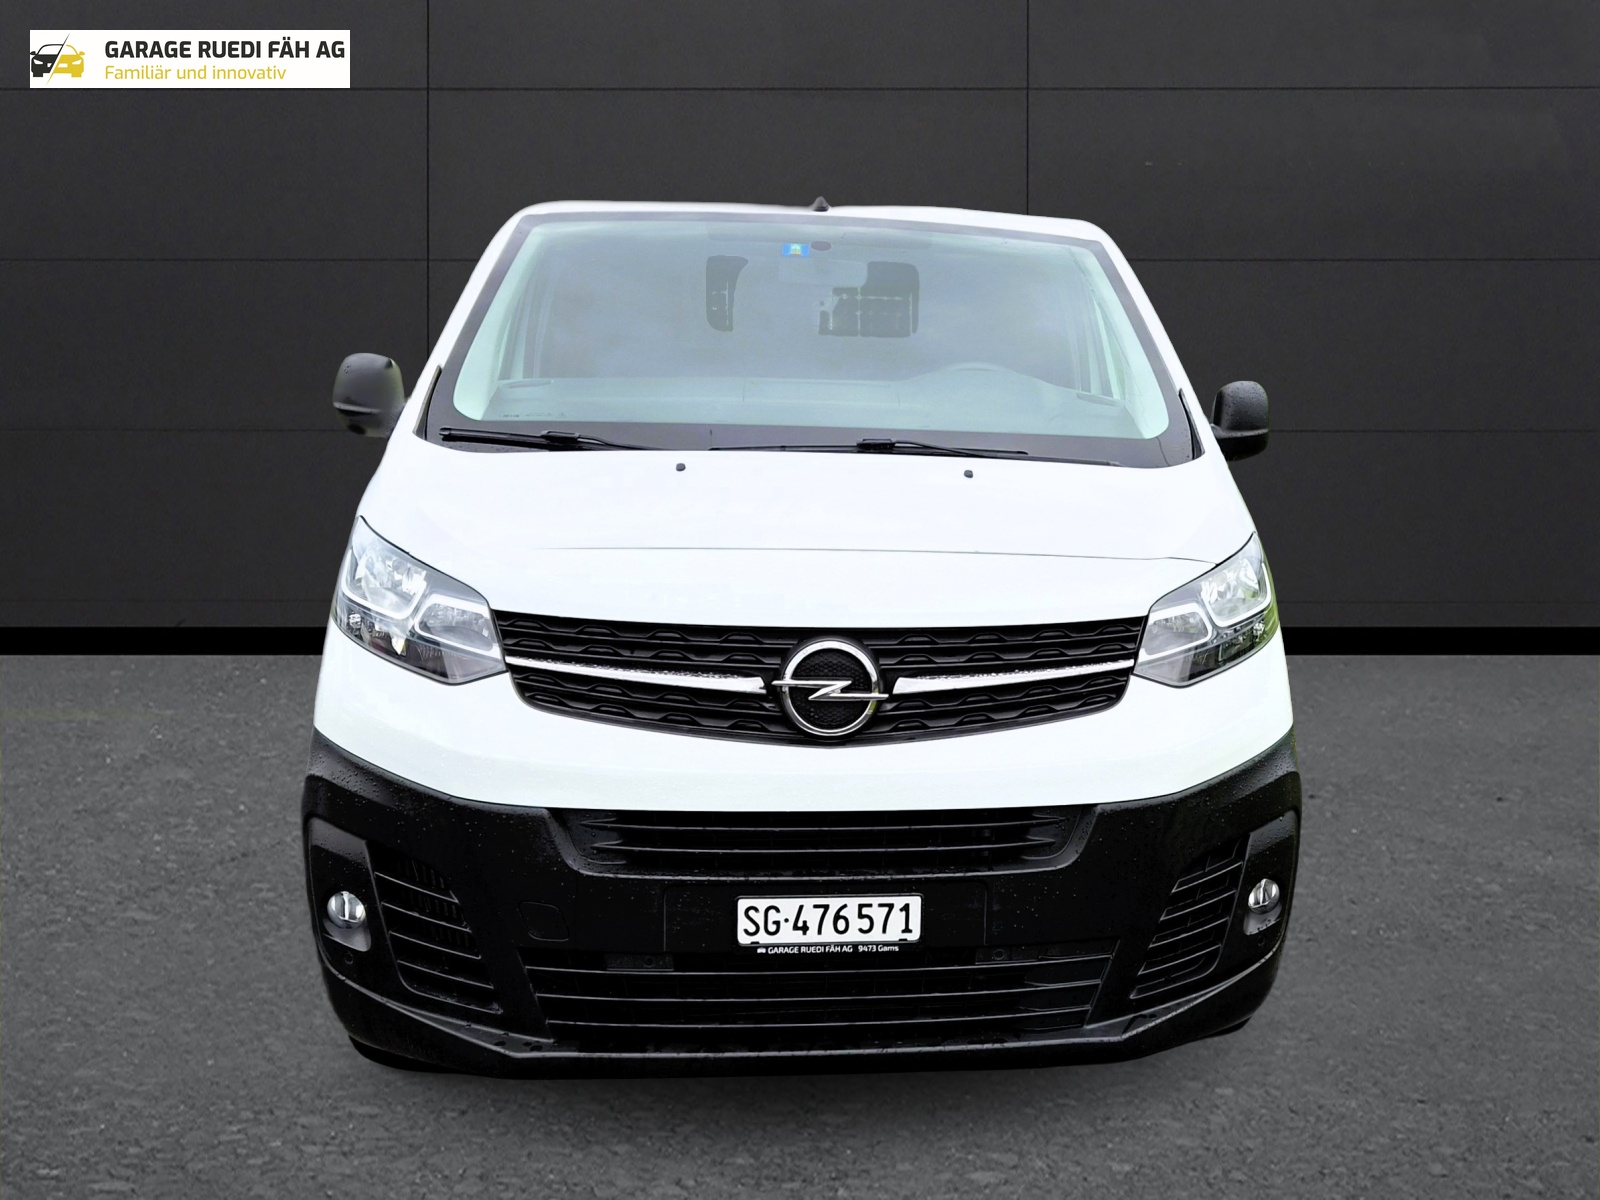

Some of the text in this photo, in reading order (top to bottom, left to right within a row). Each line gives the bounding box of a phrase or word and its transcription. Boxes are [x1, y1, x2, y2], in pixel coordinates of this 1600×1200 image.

[767, 946, 799, 954] GARAGE
[825, 944, 841, 953] FÄH
[841, 944, 853, 953] AG
[877, 944, 900, 952] Gams
